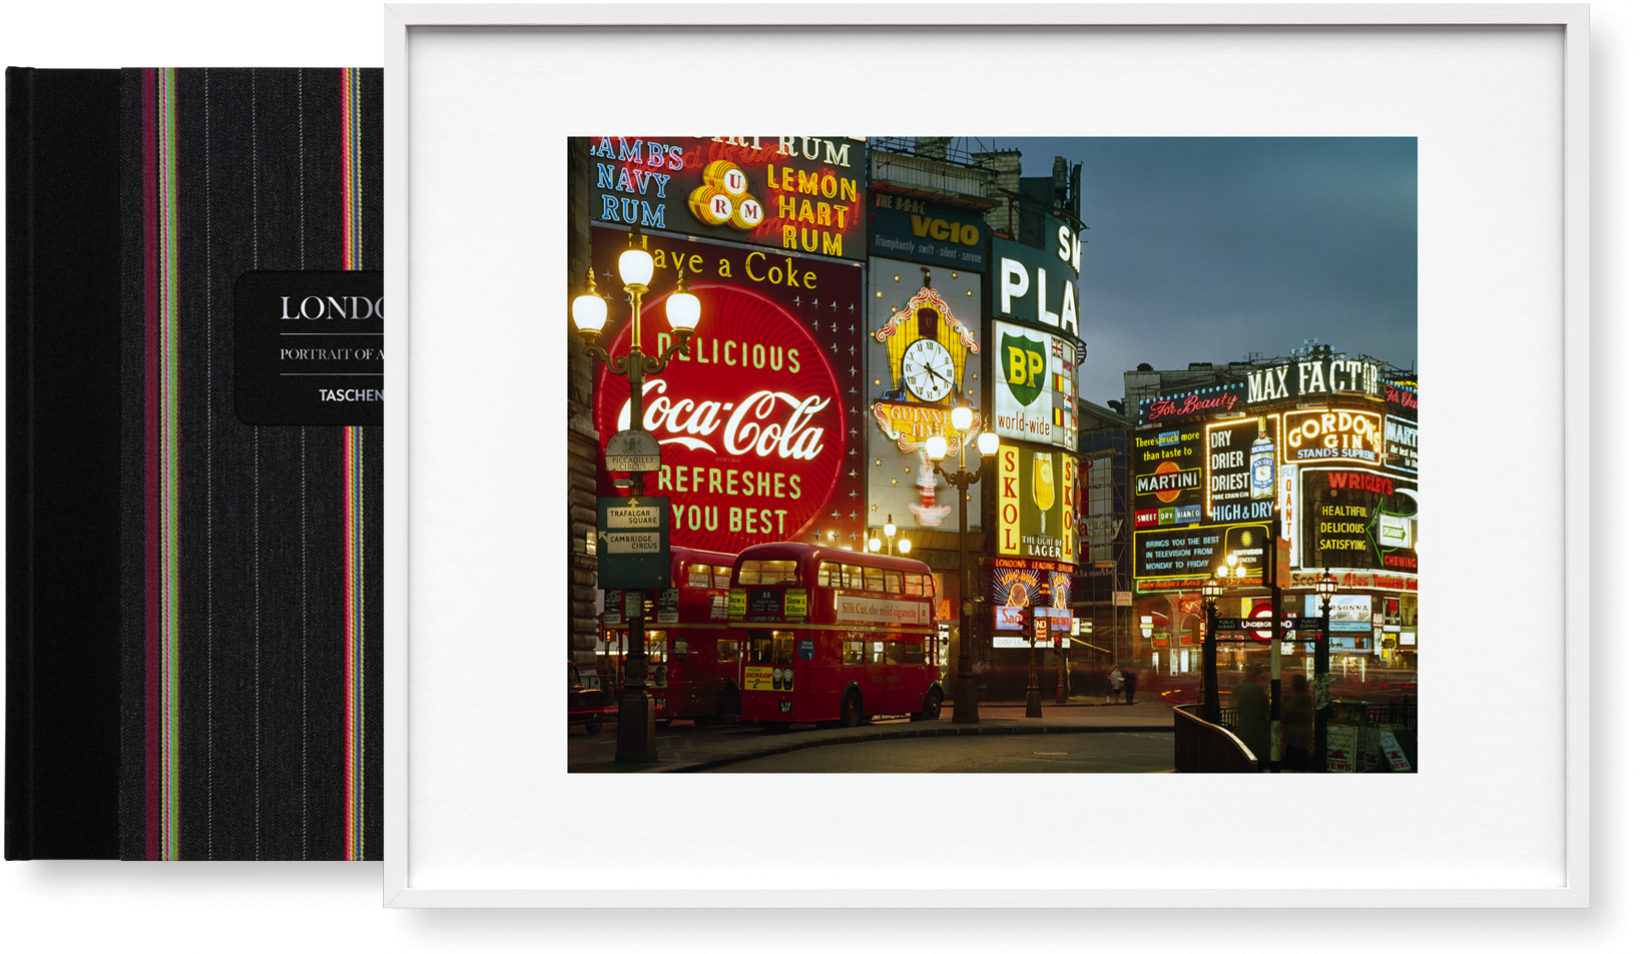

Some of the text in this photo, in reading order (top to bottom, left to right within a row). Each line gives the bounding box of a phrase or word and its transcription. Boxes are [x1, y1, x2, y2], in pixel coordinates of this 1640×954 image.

[590, 137, 683, 170] AMB'S
[776, 137, 851, 167] RUM
[597, 163, 670, 198] NAVY
[729, 174, 742, 189] U
[768, 164, 857, 203] LEMON
[715, 199, 728, 214] R
[875, 193, 893, 209] THE
[601, 194, 666, 228] RUM
[744, 204, 758, 219] M
[779, 194, 849, 229] HART
[910, 214, 979, 246] VC10
[783, 224, 842, 257] RUM
[875, 235, 982, 263] Triumphantly swift silent serene
[719, 258, 733, 277] a
[745, 252, 817, 289] Coke
[1001, 257, 1079, 337] PLA
[280, 348, 352, 360] PORTRAIT
[354, 348, 374, 360] OF
[1007, 346, 1043, 388] BP
[1247, 361, 1378, 403] MAX FACTOR
[319, 388, 384, 402] TASCHEN
[1149, 392, 1238, 420] For Beauty
[617, 378, 831, 460] Coca-Cola
[890, 407, 951, 425] GUINNE
[998, 411, 1050, 436] world-wide
[1135, 432, 1199, 448] There's much more
[1211, 430, 1232, 448] DRY
[1288, 412, 1380, 454] GORDON'S
[1324, 434, 1363, 449] GIN
[612, 456, 654, 464] PICCADILLY
[1143, 447, 1192, 461] than taste to
[1212, 450, 1244, 470] DRIER
[1297, 448, 1376, 461] STANDS SUPREME
[1282, 467, 1295, 477] FLY
[658, 465, 801, 499] REFRESHES
[1138, 472, 1197, 492] MARTINI
[1212, 472, 1249, 492] DRIEST
[1328, 472, 1393, 495] WRIGLEY'S
[1003, 450, 1018, 550] SKOL
[1064, 461, 1072, 555] SKOL
[672, 504, 788, 534] YOU BEST
[1137, 509, 1200, 522] SWEET DRY BIANCO
[1213, 501, 1274, 522] HIGH & DRY
[1322, 506, 1367, 517] HEALTHFUL
[1320, 522, 1365, 534] DELICIOUS
[610, 535, 651, 543] CAMBRIDGE
[1022, 536, 1036, 544] THE
[1037, 537, 1054, 546] LIGHT
[1146, 536, 1219, 548] BRINGS YOU THE BEST
[1320, 539, 1366, 551] SATISFYING
[1028, 545, 1061, 558] LAGER
[1155, 549, 1191, 558] TELEVISION
[1194, 548, 1213, 556] FROM
[995, 558, 1055, 570] LONDON'S LEADING
[1187, 560, 1208, 568] FRIDAY
[1384, 555, 1417, 568] CHEWING
[1292, 572, 1337, 587] Scoth
[1341, 572, 1369, 587] Ales
[762, 591, 771, 599] 88
[842, 602, 917, 621] Silk the mild cigarette
[1037, 620, 1046, 629] NO
[1241, 620, 1294, 630] UNDERGRND
[753, 679, 760, 689] 2
